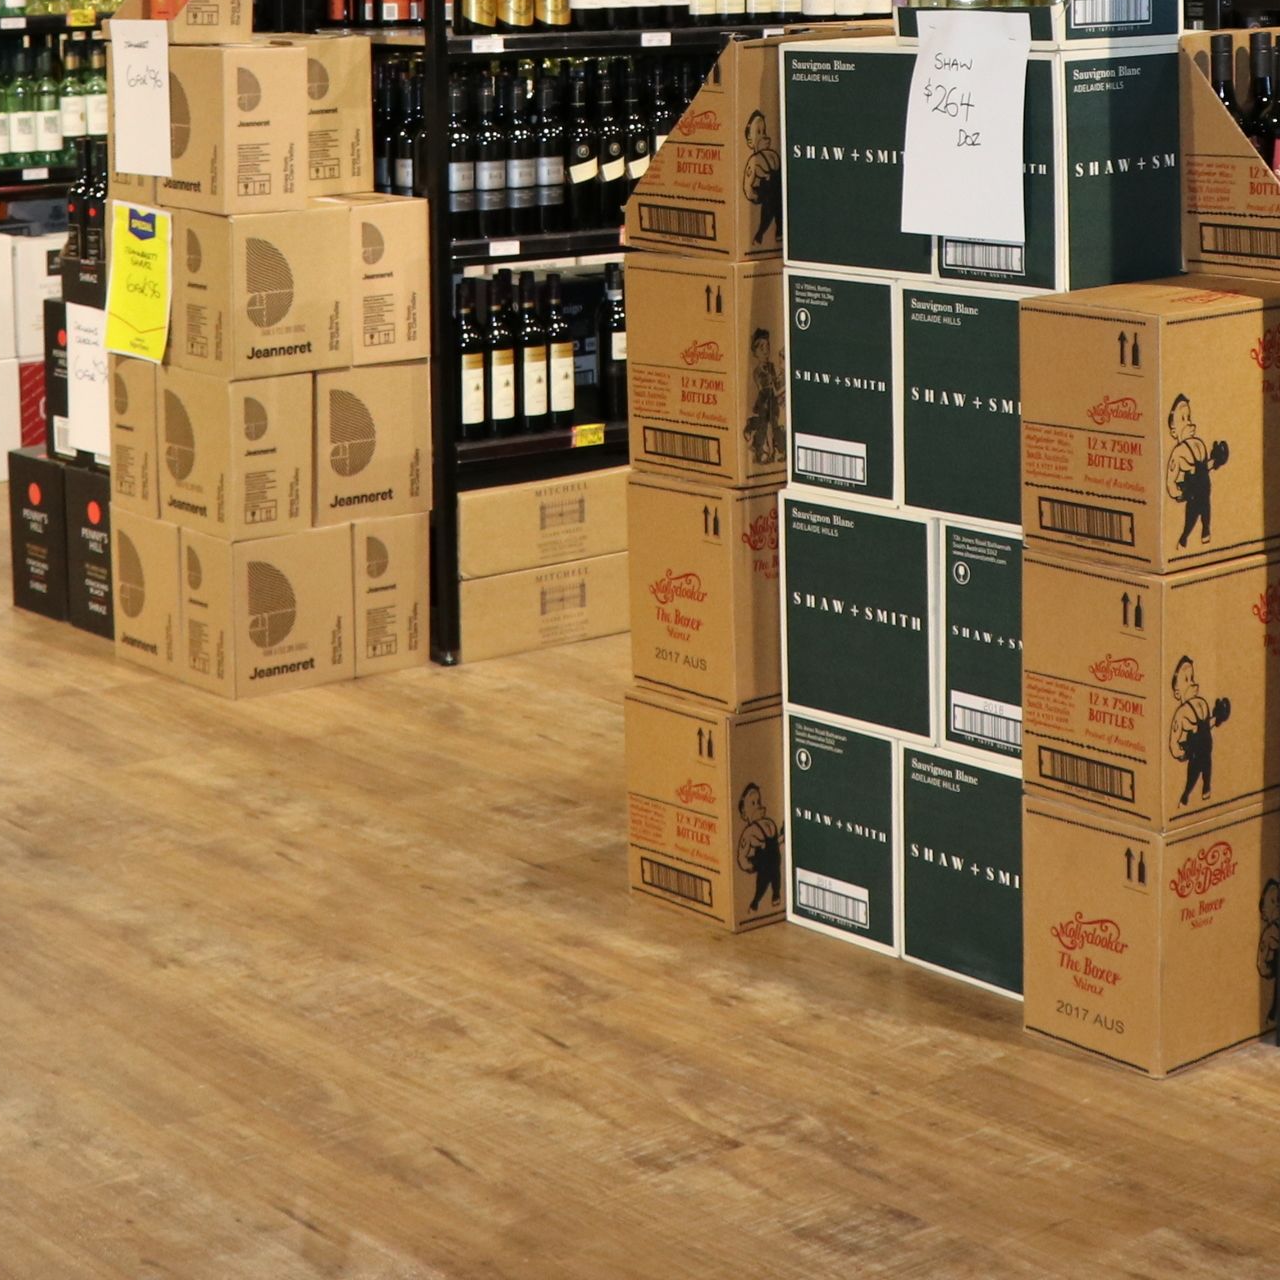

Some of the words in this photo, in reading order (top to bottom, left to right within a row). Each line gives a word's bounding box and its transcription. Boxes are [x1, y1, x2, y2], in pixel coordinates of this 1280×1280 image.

[792, 59, 831, 74] Sauvignon
[833, 60, 856, 72] Blanc
[934, 52, 973, 71] SHAW
[792, 73, 820, 82] ADELAIDE
[821, 74, 839, 83] HILLS
[1073, 68, 1116, 84] Sauvignon
[1118, 65, 1141, 78] Blanc
[1073, 83, 1104, 93] ADELAIDE
[1106, 80, 1124, 91] HILLS
[308, 107, 339, 116] Jeanneret
[676, 146, 685, 159] 12
[696, 147, 722, 162] 750ML
[793, 144, 846, 161] SHAW
[676, 161, 714, 176] BOTTLES
[1075, 157, 1131, 178] SHAW
[1249, 166, 1260, 179] 12
[163, 176, 202, 193] Jeanneret
[362, 271, 394, 281] Jeanneret
[911, 298, 953, 313] Sauvignon
[955, 303, 979, 316] Blanc
[911, 313, 942, 324] ADELAIDE
[942, 316, 962, 326] HILLS
[246, 341, 312, 361] Jeanneret
[681, 375, 690, 389] 12
[699, 377, 725, 392] 750ML
[795, 370, 831, 384] SHAW
[844, 376, 887, 392] SMITH
[681, 390, 718, 405] BOTTLES
[911, 386, 967, 408] SHAW
[1088, 436, 1098, 448] 12
[1109, 437, 1143, 457] 750ML
[1087, 453, 1134, 471] BOTTLES
[329, 488, 394, 509] Jeanneret
[535, 482, 589, 497] MITCHELL
[168, 495, 207, 518] Jeanneret
[792, 507, 831, 524] Sauvignon
[833, 515, 855, 529] Blanc
[792, 521, 821, 534] ADELAIDE
[821, 526, 839, 538] HILLS
[535, 567, 590, 582] MITCHELL
[655, 606, 673, 623] The
[674, 609, 704, 632] Boxer
[793, 591, 846, 615] SHAW
[865, 607, 922, 632] SMITH
[121, 631, 158, 656] Jeanneret
[952, 625, 993, 644] SHAW
[249, 657, 315, 681] Jeanneret
[655, 647, 681, 666] 2017
[683, 654, 708, 671] AUS
[1089, 691, 1098, 706] 12
[1112, 697, 1145, 717] 750ML
[1088, 708, 1135, 731] BOTTLES
[911, 757, 953, 779] Sauvignon
[955, 770, 979, 786] Blanc
[911, 772, 941, 787] ADELAIDE
[942, 779, 961, 793] HILLS
[676, 825, 712, 846] BOTTLES
[796, 807, 832, 825] SHAW
[846, 822, 887, 843] SMITH
[911, 843, 965, 871] SHAW
[1180, 908, 1195, 922] The
[1198, 897, 1225, 917] Boxer
[1057, 951, 1081, 973] The
[1083, 957, 1121, 986] Boxer
[1072, 975, 1105, 997] Shiraz
[1056, 999, 1089, 1021] 2017
[1093, 1014, 1126, 1035] AUS
